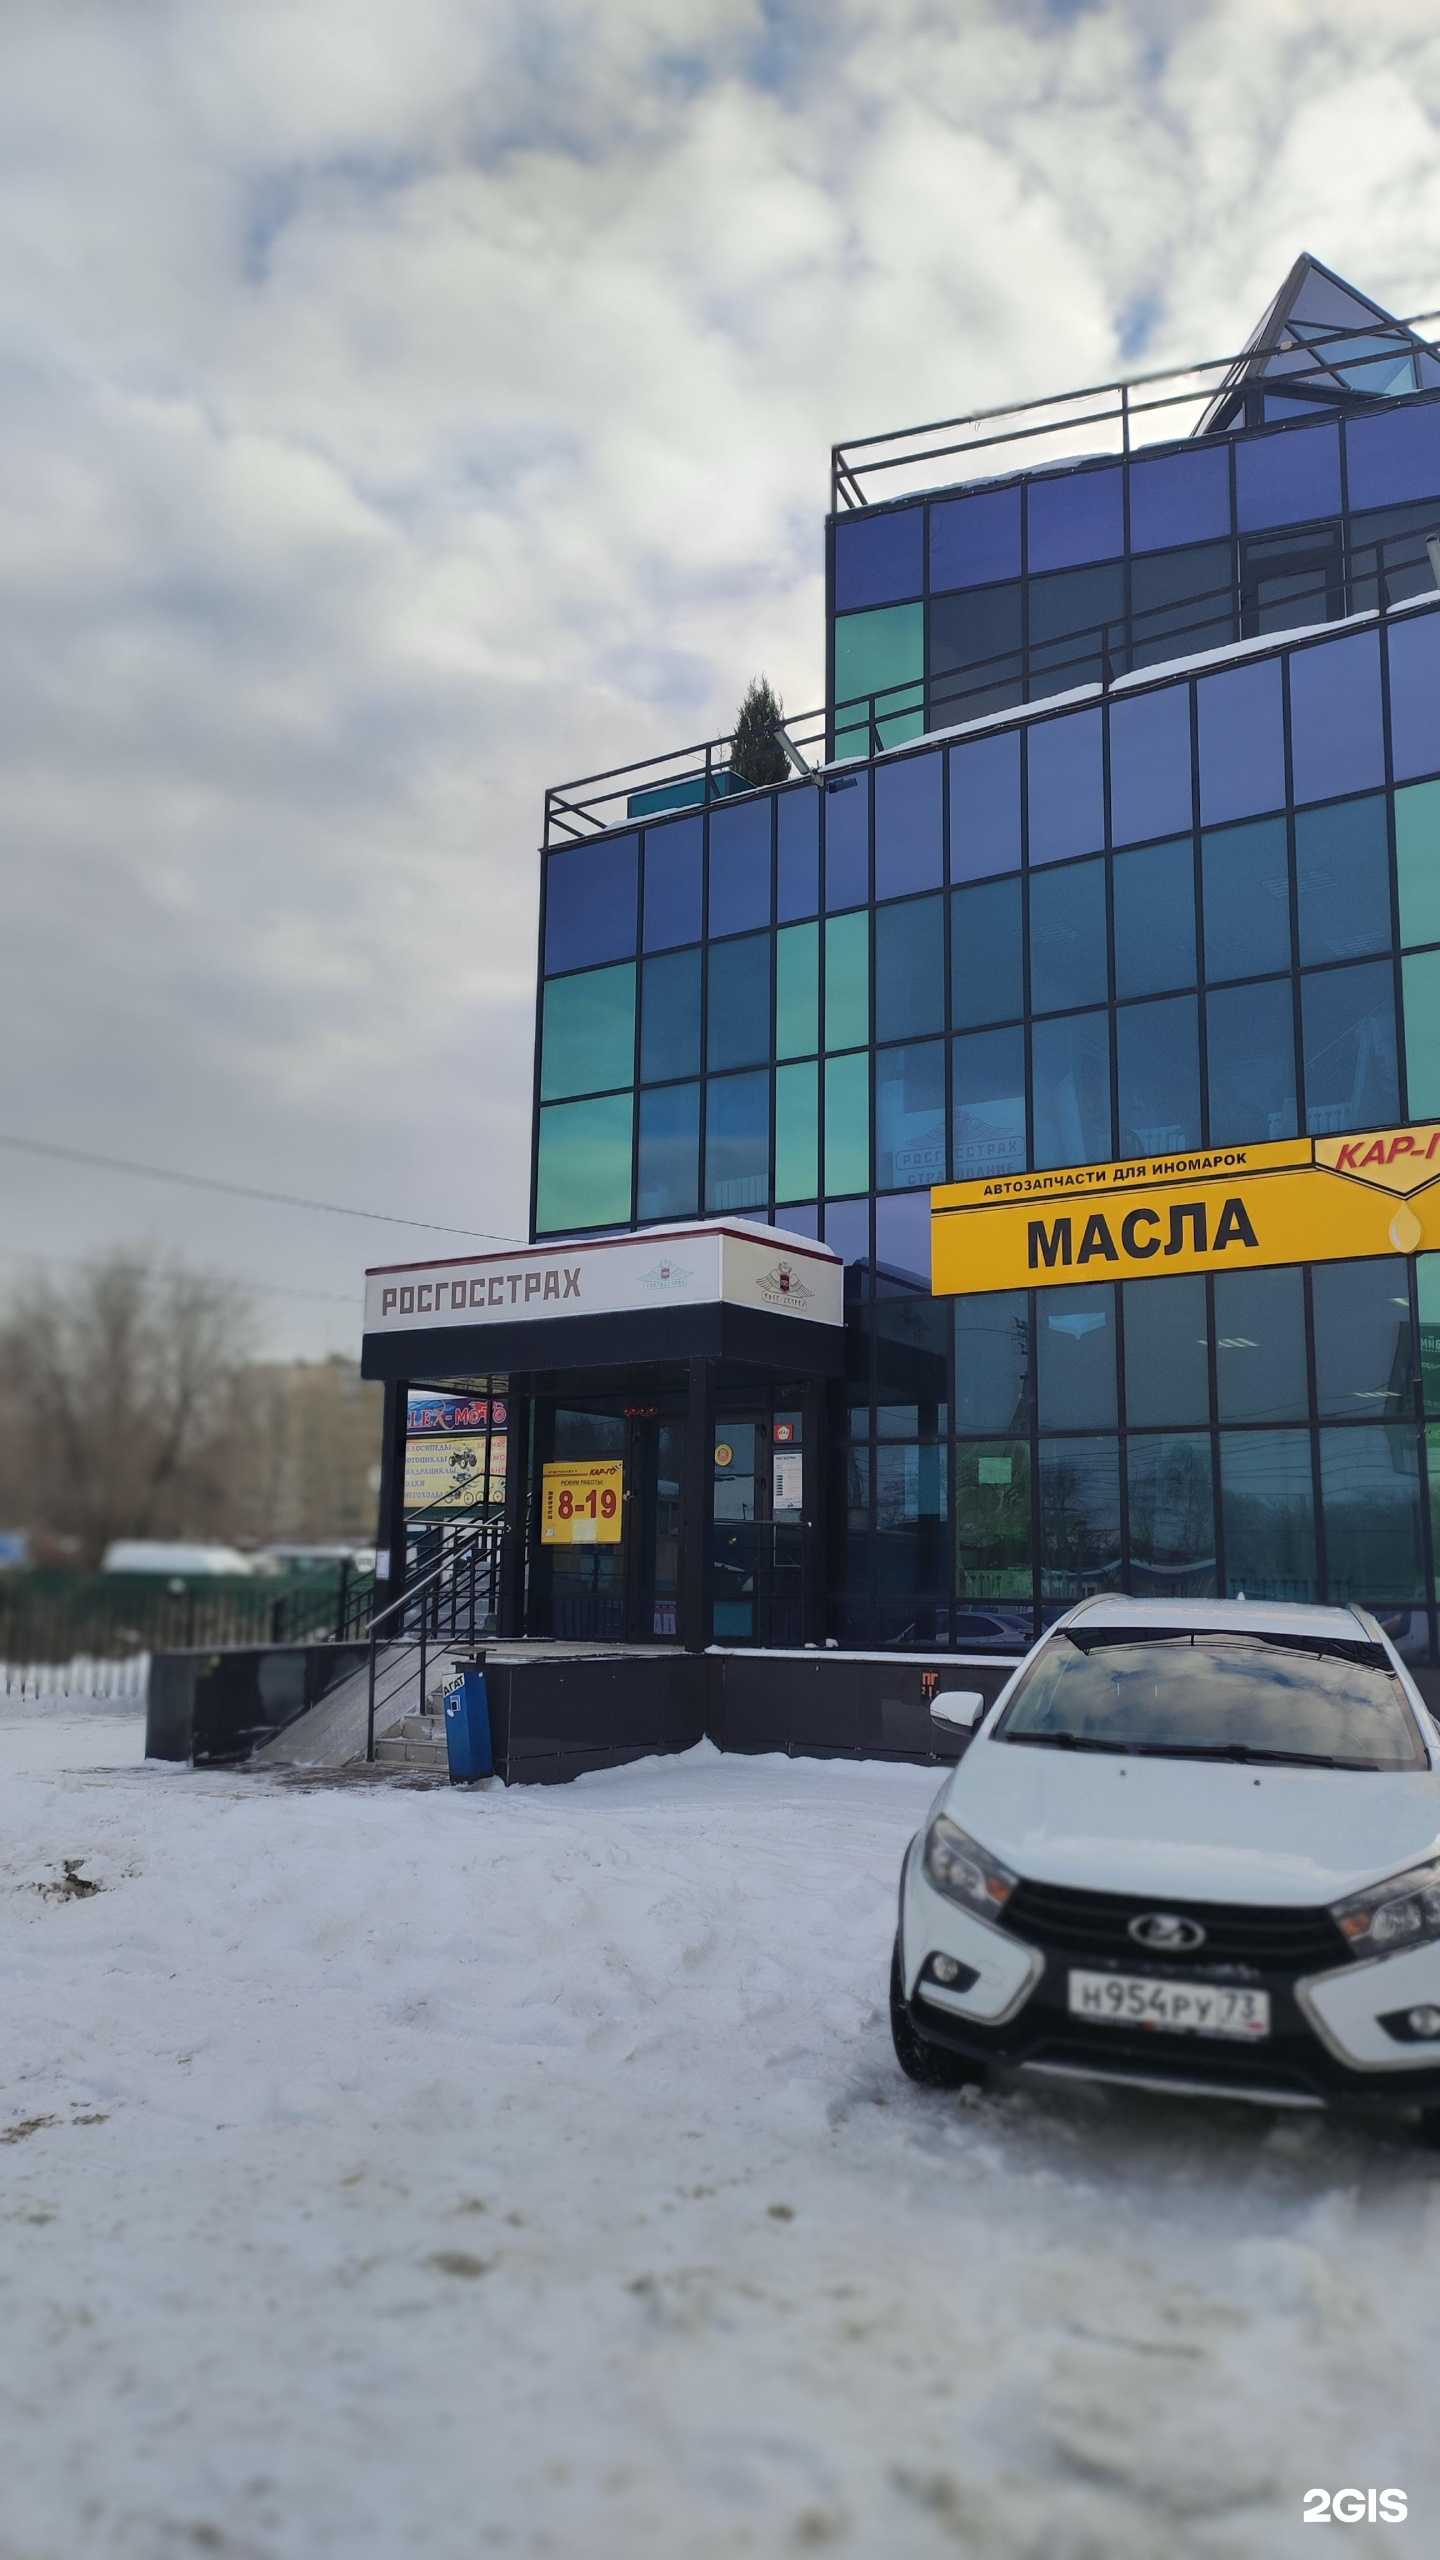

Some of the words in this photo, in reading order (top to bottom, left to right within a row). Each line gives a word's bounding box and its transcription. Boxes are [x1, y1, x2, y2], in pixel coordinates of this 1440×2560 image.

[983, 1171, 1106, 1196] АВТОЗАПЧАСТИ
[1113, 1165, 1146, 1182] ДЛЯ
[1152, 1152, 1247, 1175] ИНОМАРОК
[1027, 1197, 1259, 1269] МАСЛА
[382, 1267, 581, 1316] РОСГОССТРАХ
[558, 1488, 617, 1519] 8-19
